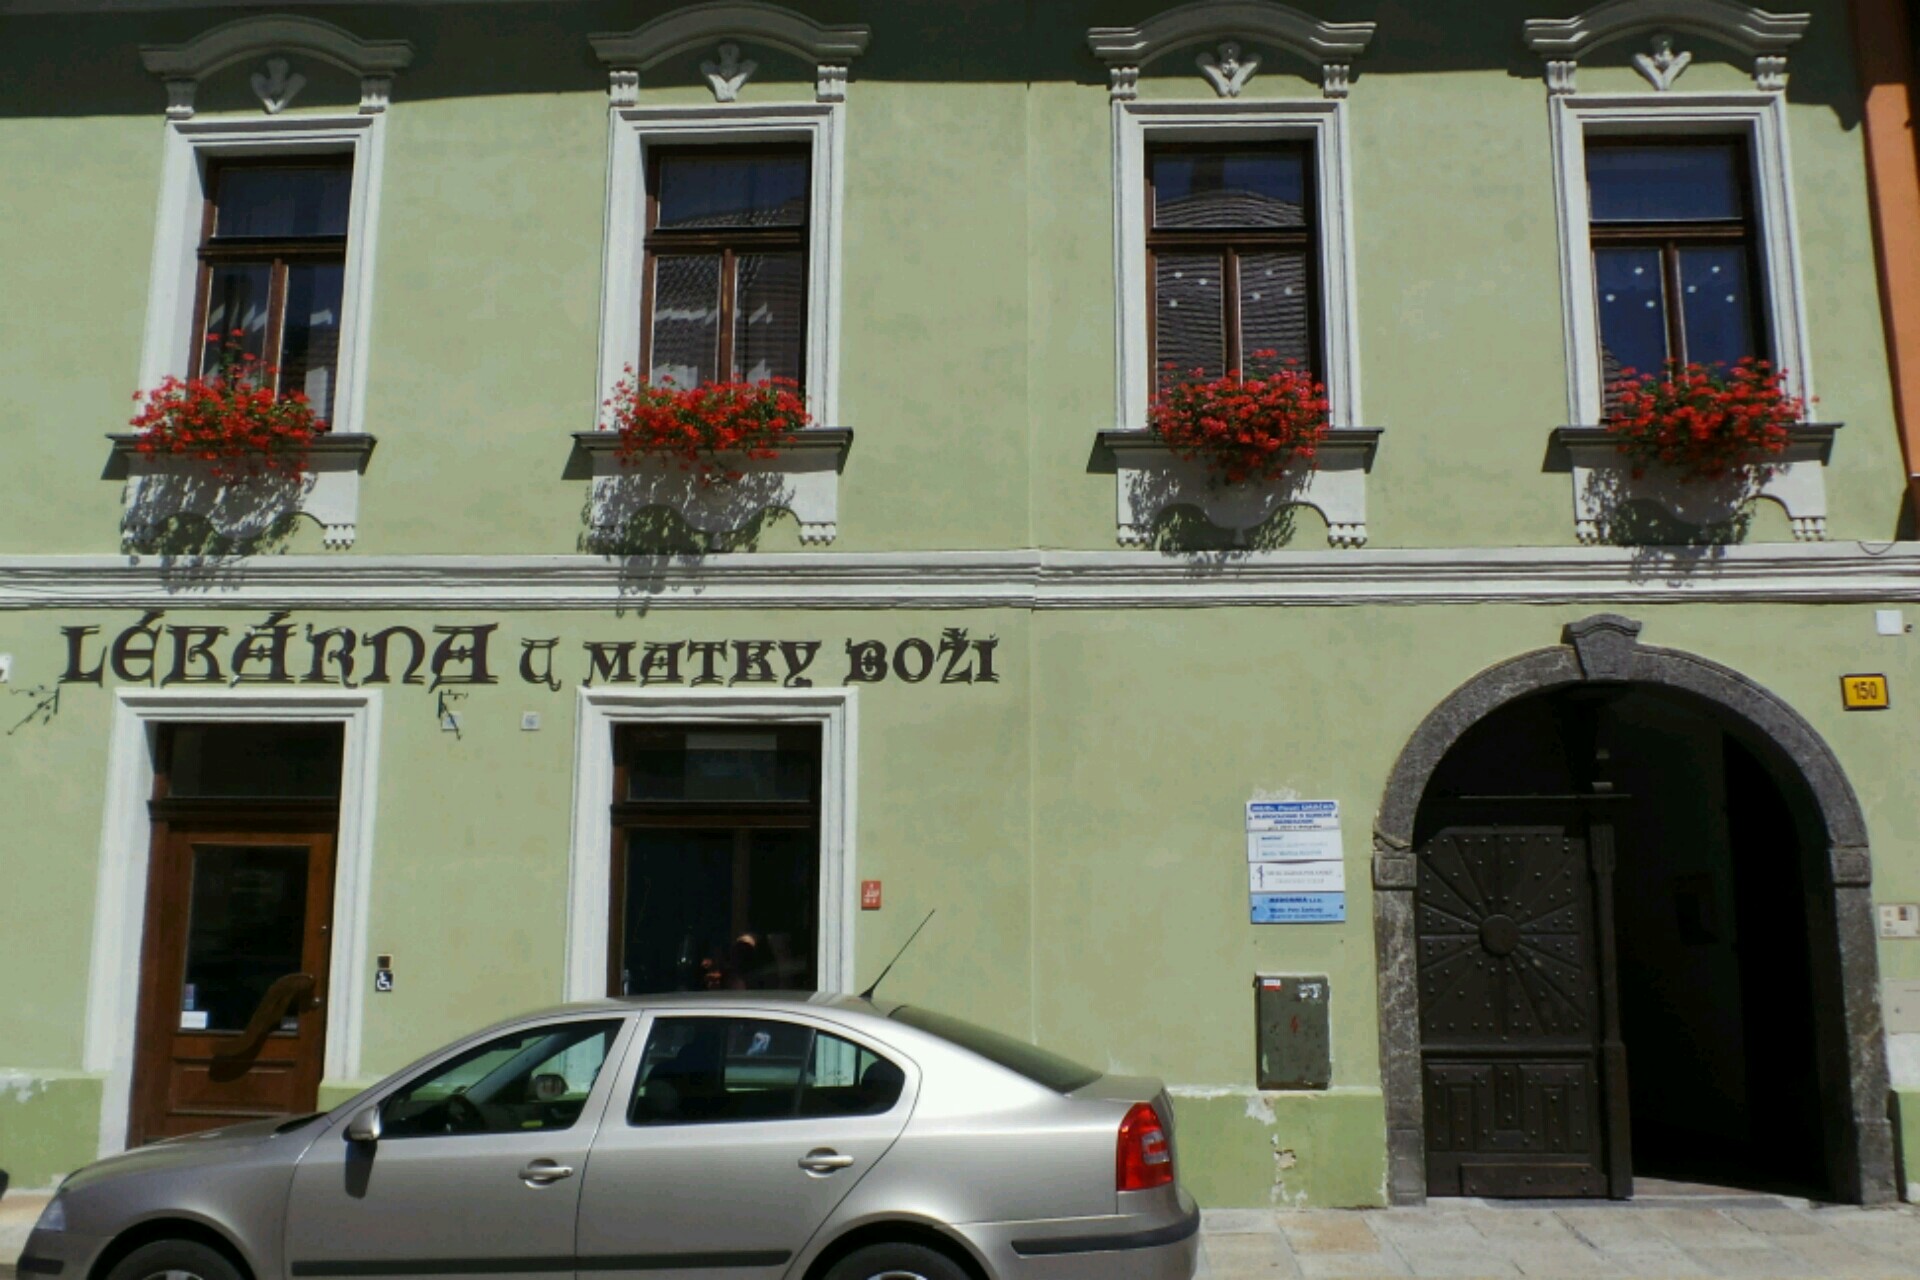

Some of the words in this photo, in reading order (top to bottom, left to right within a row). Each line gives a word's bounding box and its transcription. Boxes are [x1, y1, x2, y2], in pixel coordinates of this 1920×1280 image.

[58, 610, 498, 691] LÉKÁRNA
[520, 637, 562, 692] U
[583, 640, 822, 688] MATKY
[1852, 681, 1878, 700] 150
